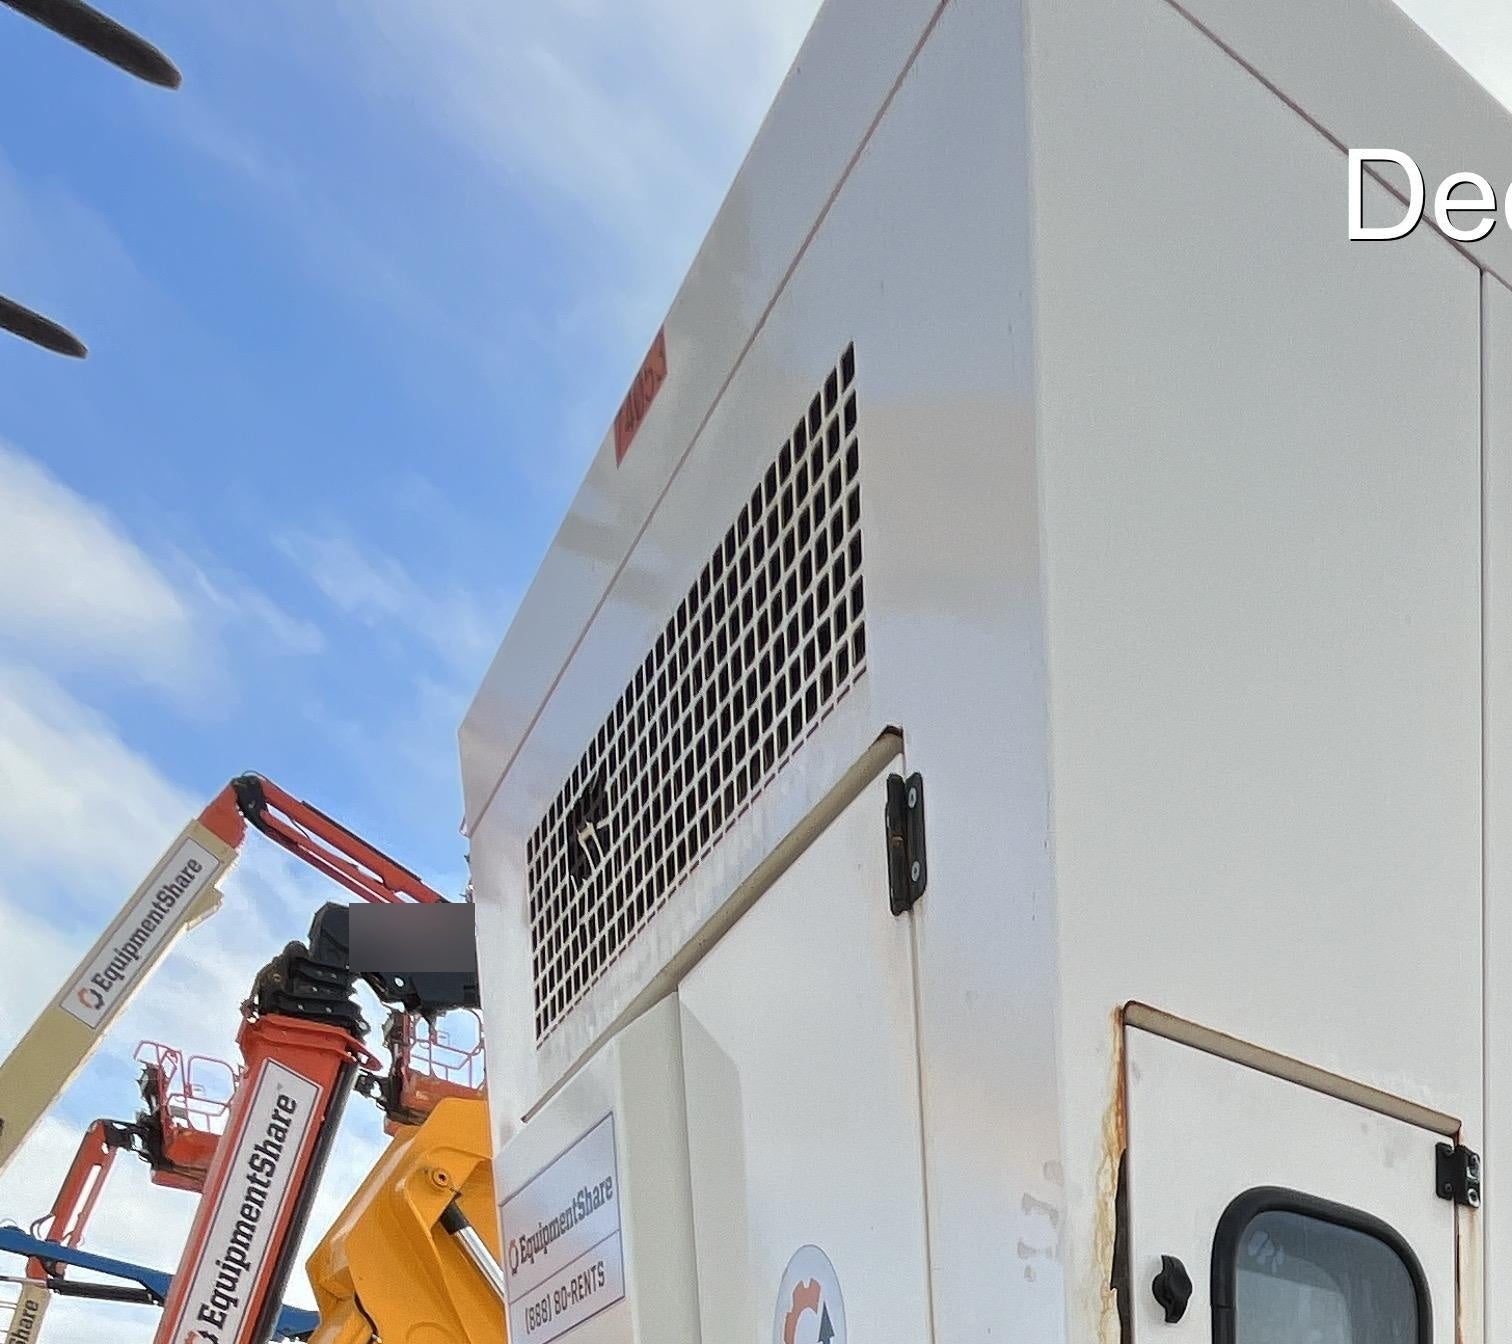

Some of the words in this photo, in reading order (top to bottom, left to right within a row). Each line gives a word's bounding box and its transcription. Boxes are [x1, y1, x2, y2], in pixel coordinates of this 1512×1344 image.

[92, 859, 203, 992] EquipmentShare
[200, 1094, 297, 1331] EquipmentShare
[520, 1176, 613, 1264] EquipmentShare
[525, 1294, 552, 1334] (888)
[555, 1261, 605, 1314] 80-RENTS
